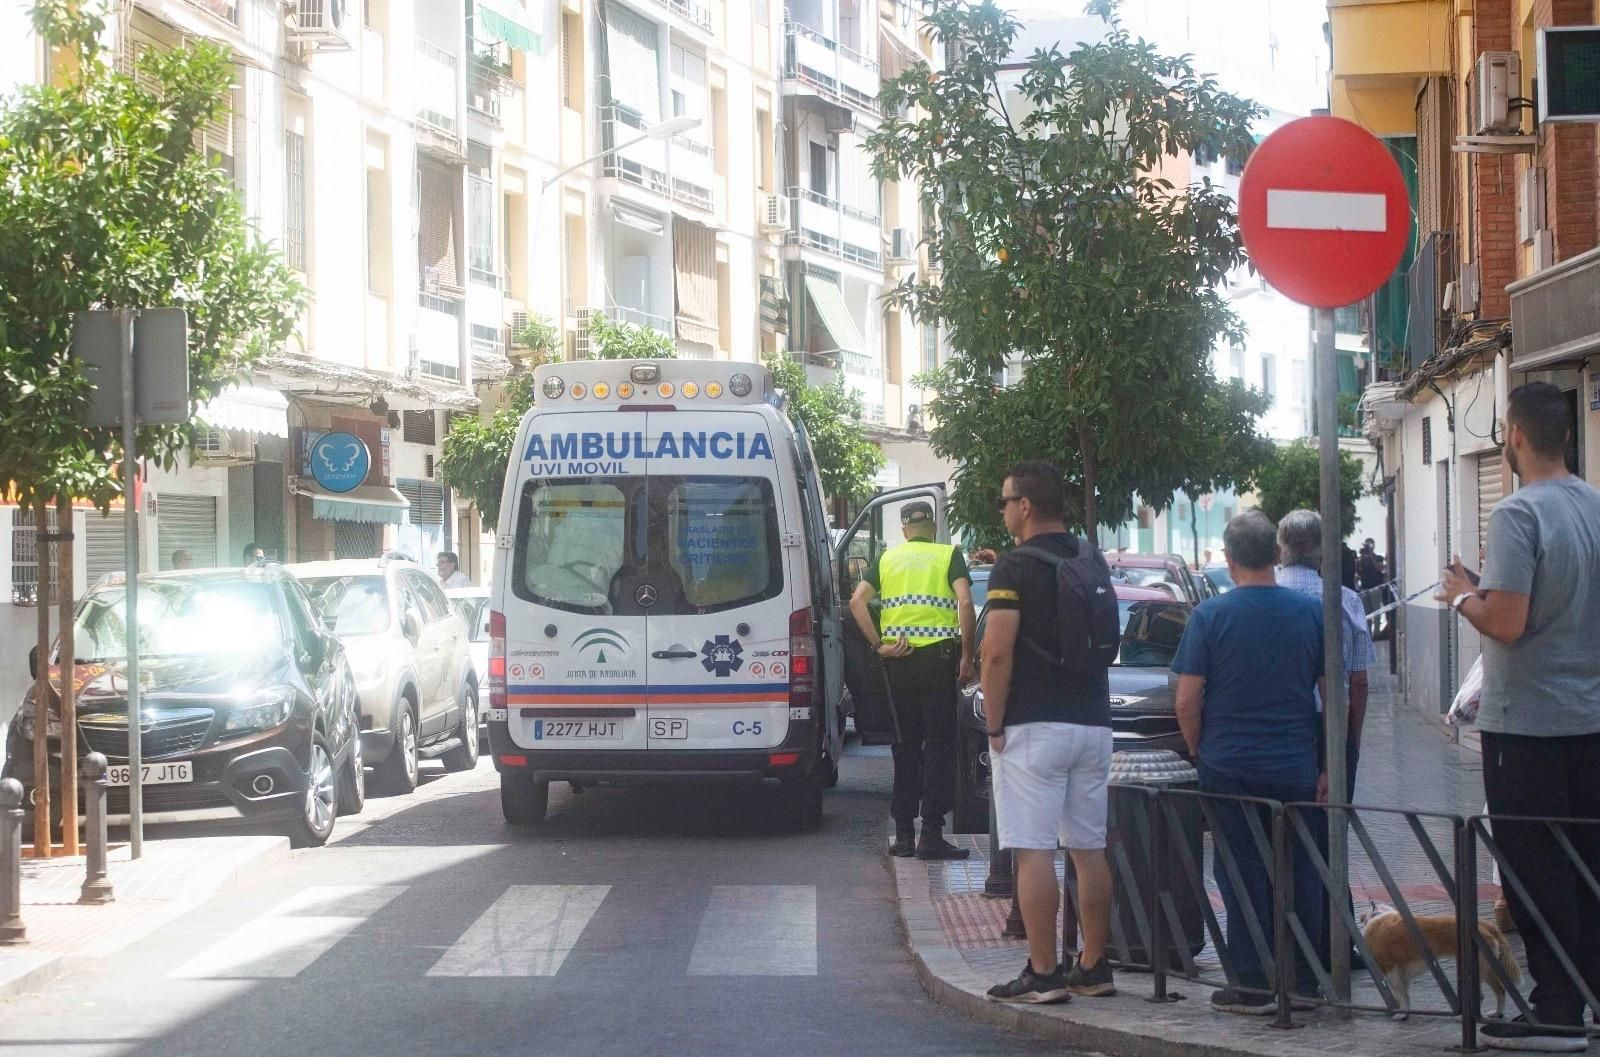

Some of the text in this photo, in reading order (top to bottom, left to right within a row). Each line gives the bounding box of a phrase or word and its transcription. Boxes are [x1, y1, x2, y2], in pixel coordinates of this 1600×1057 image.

[524, 431, 773, 461] AMBULANCIA
[530, 461, 630, 476] UVI MOVIL
[589, 670, 597, 679] DE
[546, 722, 617, 737] 2277 HJT
[732, 720, 762, 736] C-5
[110, 764, 187, 784] 967 JTG
